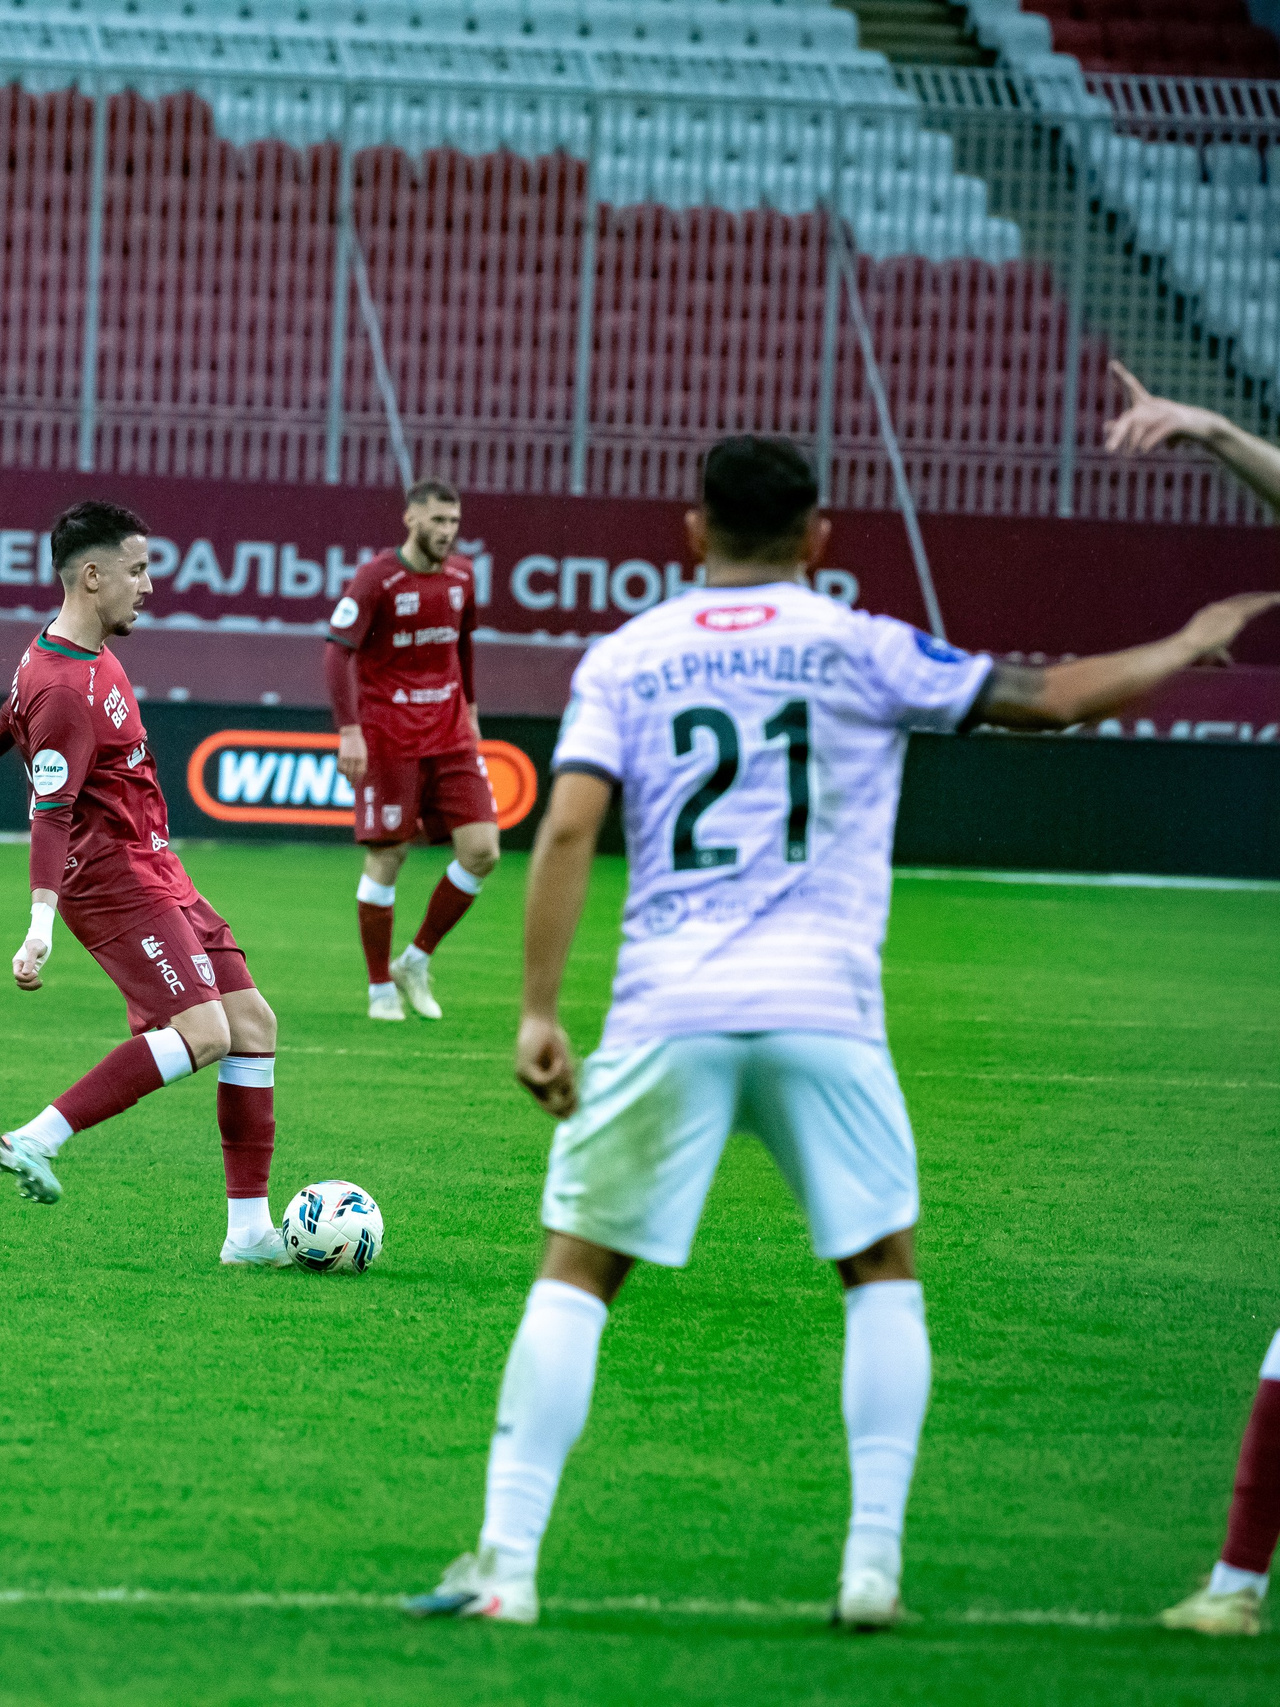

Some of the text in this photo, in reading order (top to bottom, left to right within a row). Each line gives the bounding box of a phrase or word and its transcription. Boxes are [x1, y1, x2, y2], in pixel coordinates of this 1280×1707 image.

[104, 684, 121, 717] FON
[111, 697, 129, 729] BET
[43, 765, 63, 773] МИР
[671, 700, 813, 874] 21
